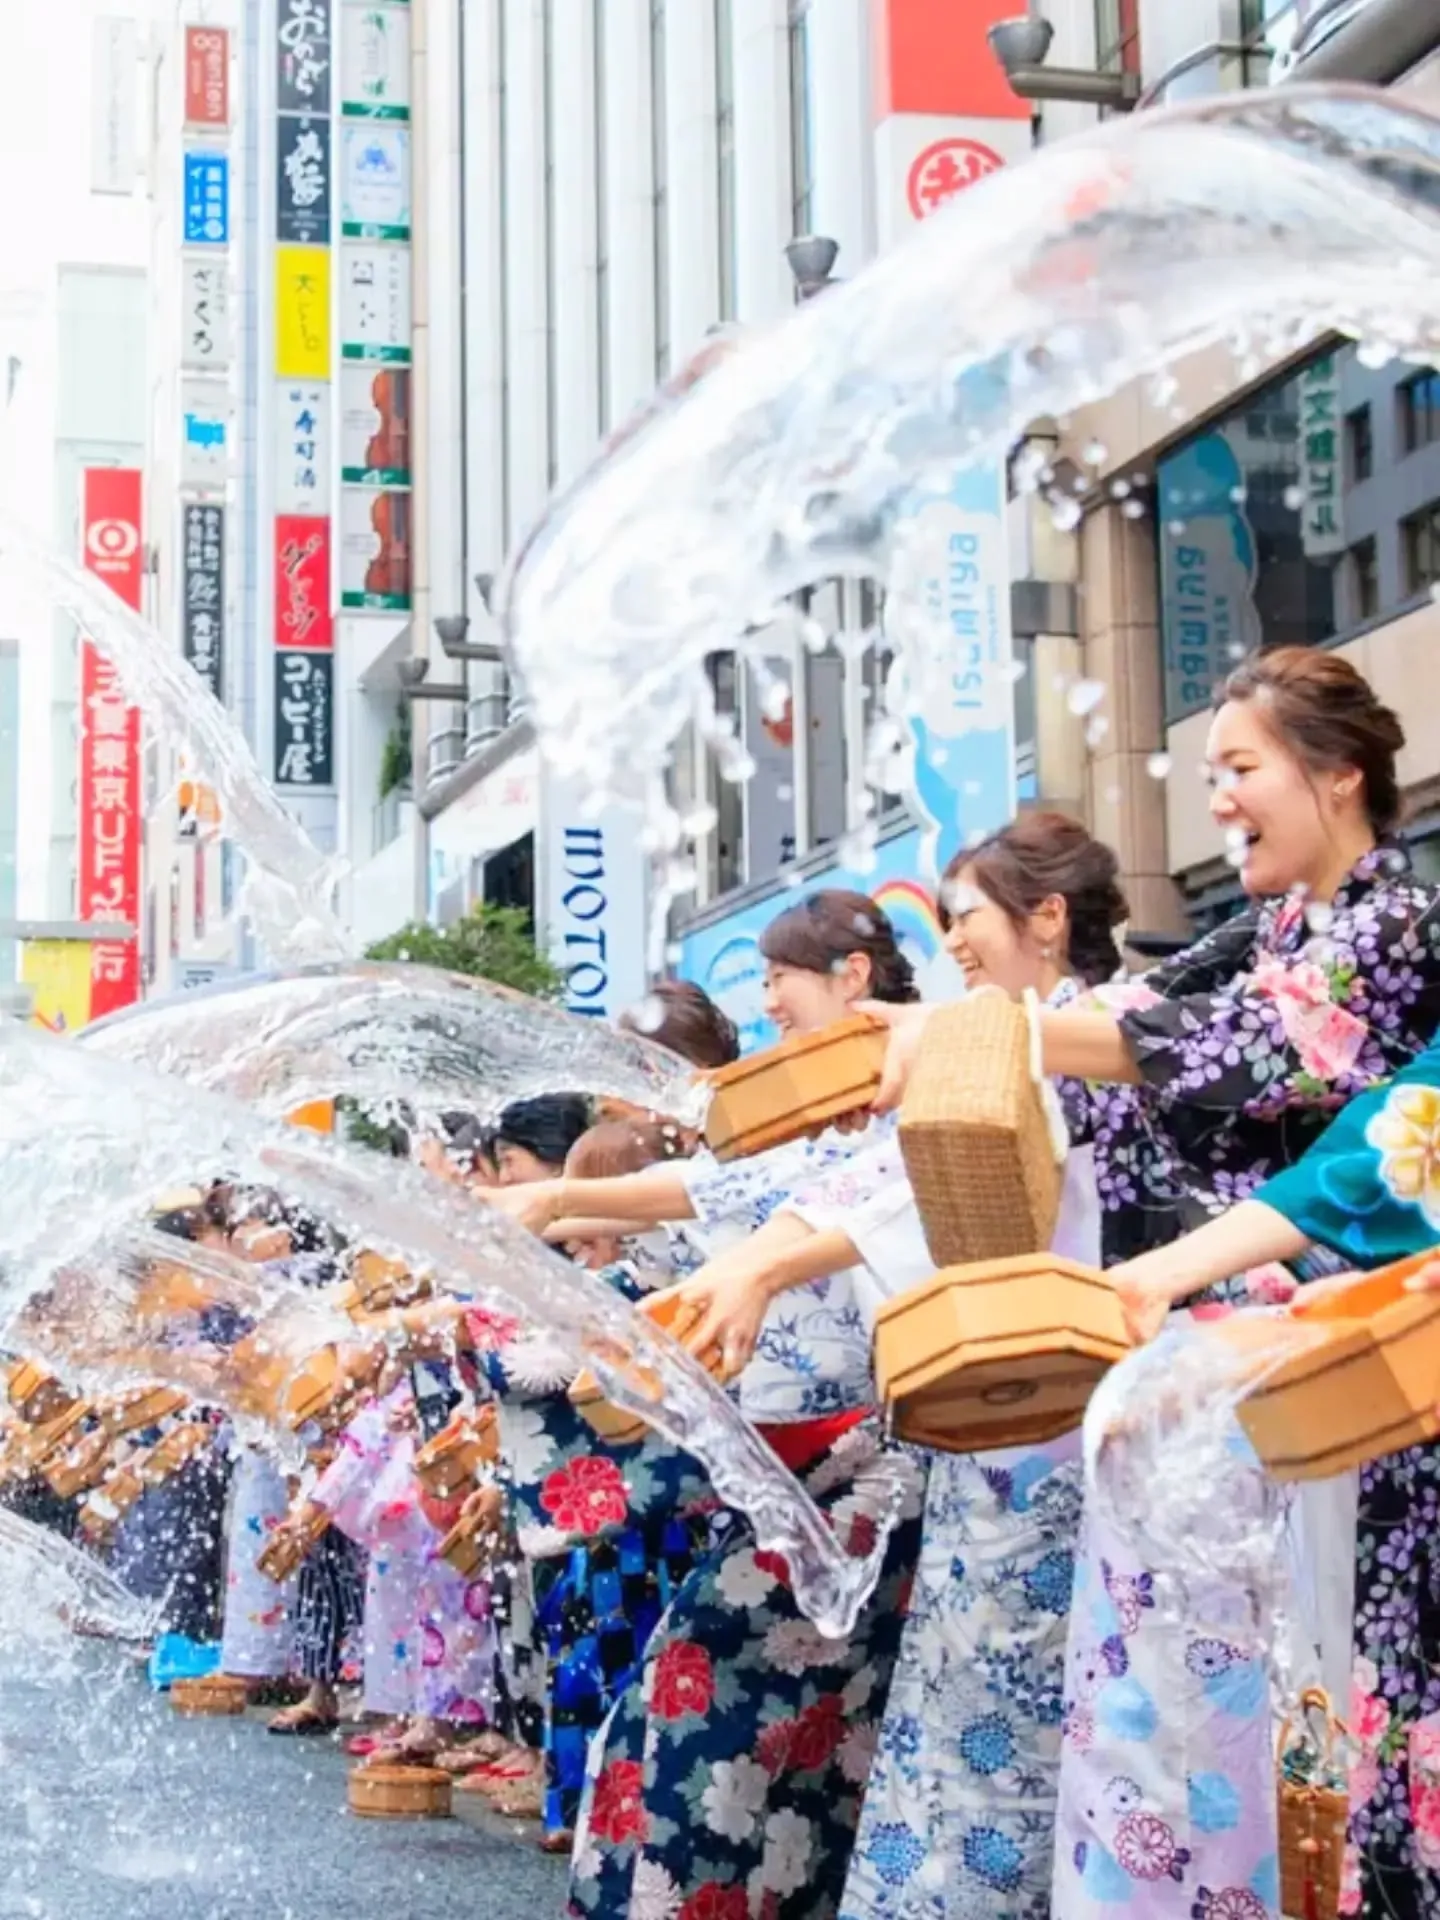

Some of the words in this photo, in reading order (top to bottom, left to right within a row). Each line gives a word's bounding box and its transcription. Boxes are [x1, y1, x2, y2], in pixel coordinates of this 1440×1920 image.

[279, 655, 312, 781] コーヒー屋
